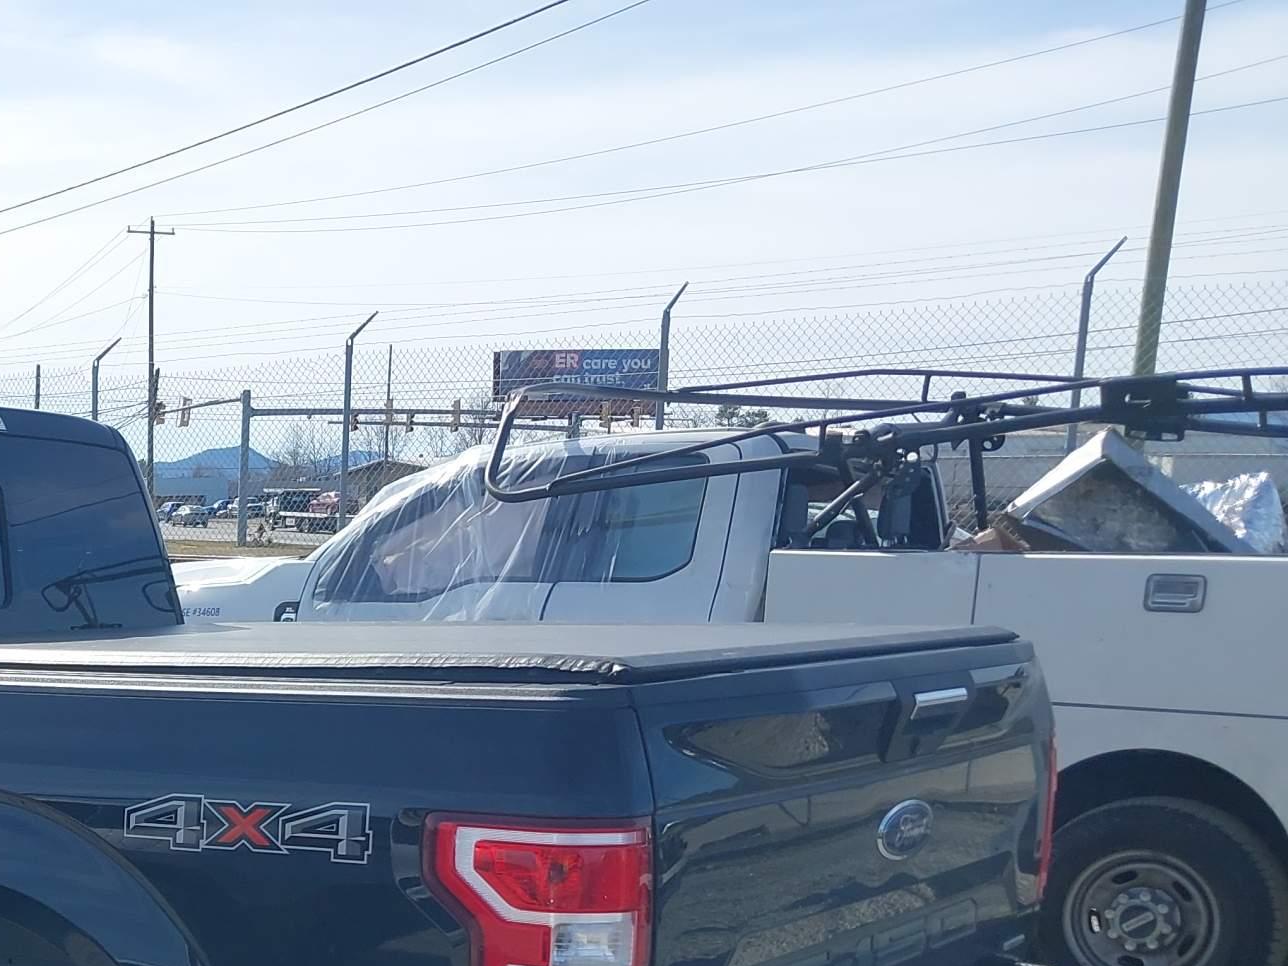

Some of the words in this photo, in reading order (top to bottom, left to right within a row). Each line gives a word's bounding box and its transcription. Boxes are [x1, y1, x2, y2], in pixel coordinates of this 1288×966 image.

[554, 352, 579, 368] ER
[583, 359, 617, 369] care
[622, 358, 651, 372] you
